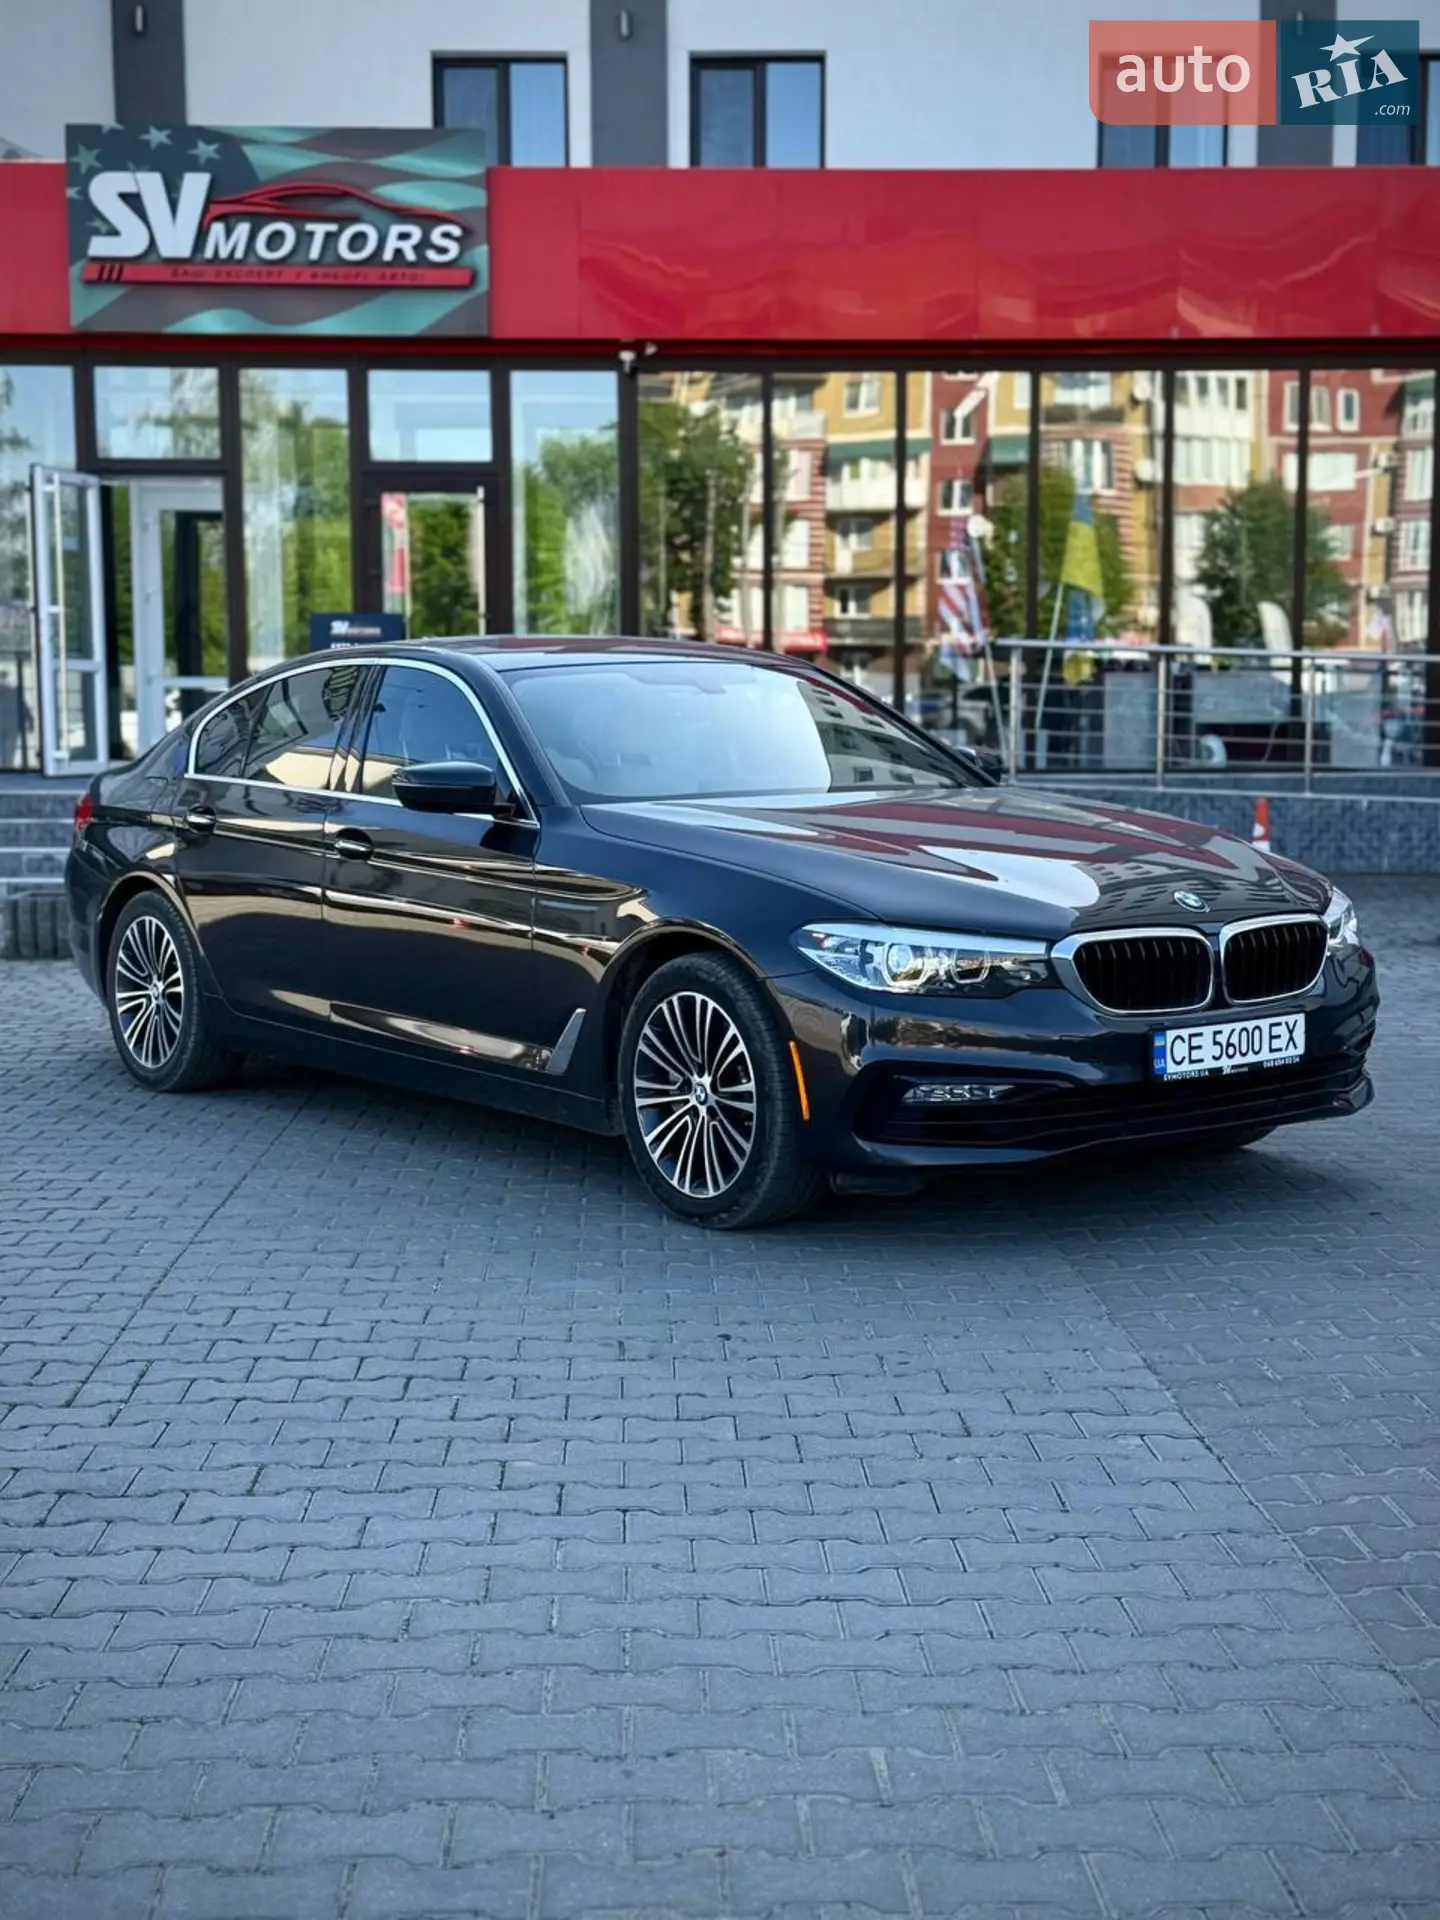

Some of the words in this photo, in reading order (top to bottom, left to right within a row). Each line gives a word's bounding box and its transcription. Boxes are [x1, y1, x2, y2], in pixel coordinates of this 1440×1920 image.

[87, 171, 212, 258] SV
[204, 221, 464, 263] MOTORS
[1170, 1032, 1204, 1066] CE
[1211, 1025, 1263, 1061] 5600
[1268, 1019, 1298, 1053] EX
